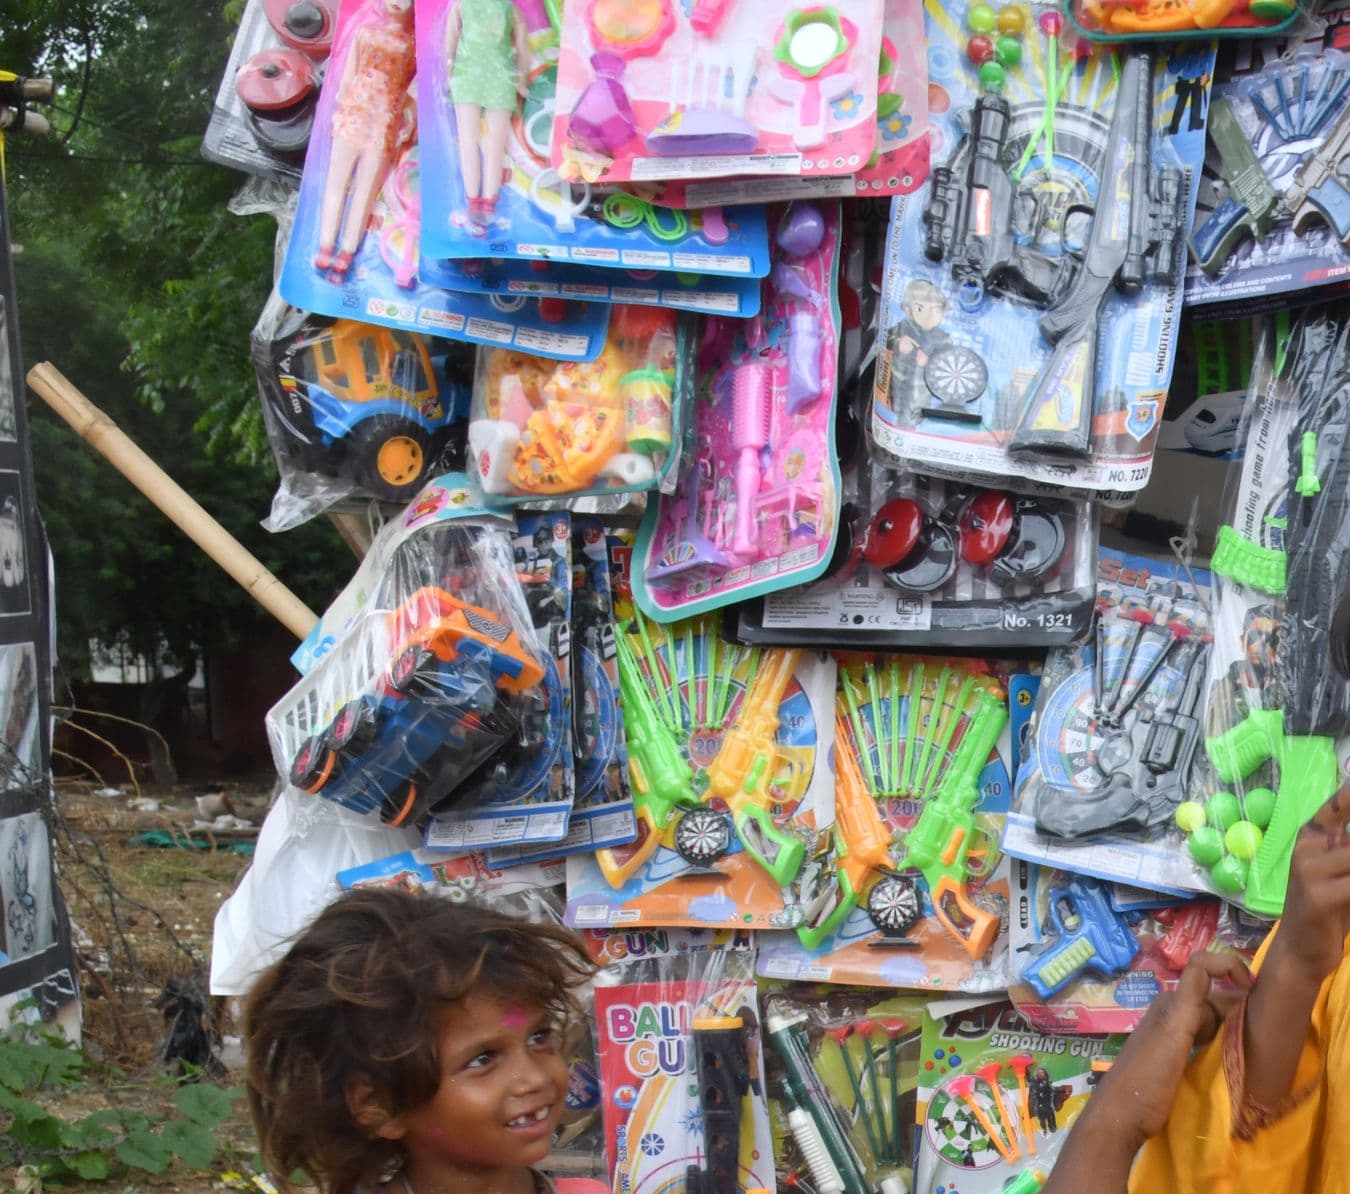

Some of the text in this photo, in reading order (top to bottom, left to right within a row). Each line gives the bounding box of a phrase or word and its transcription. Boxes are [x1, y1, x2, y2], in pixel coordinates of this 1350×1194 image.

[1154, 316, 1172, 375] SHOOTING
[1255, 419, 1271, 450] from
[1109, 470, 1128, 482] NO.
[1252, 454, 1267, 492] game
[1101, 558, 1151, 589] Set
[1004, 613, 1073, 628] No. 1321
[787, 715, 804, 729] 40
[1075, 719, 1088, 729] 90
[1071, 738, 1083, 748] 70
[1072, 756, 1086, 767] 40
[1082, 774, 1095, 785] 20
[606, 929, 670, 960] GUN
[990, 1033, 1104, 1058] SHOOTING GUN
[616, 1126, 627, 1162] SPORTS
